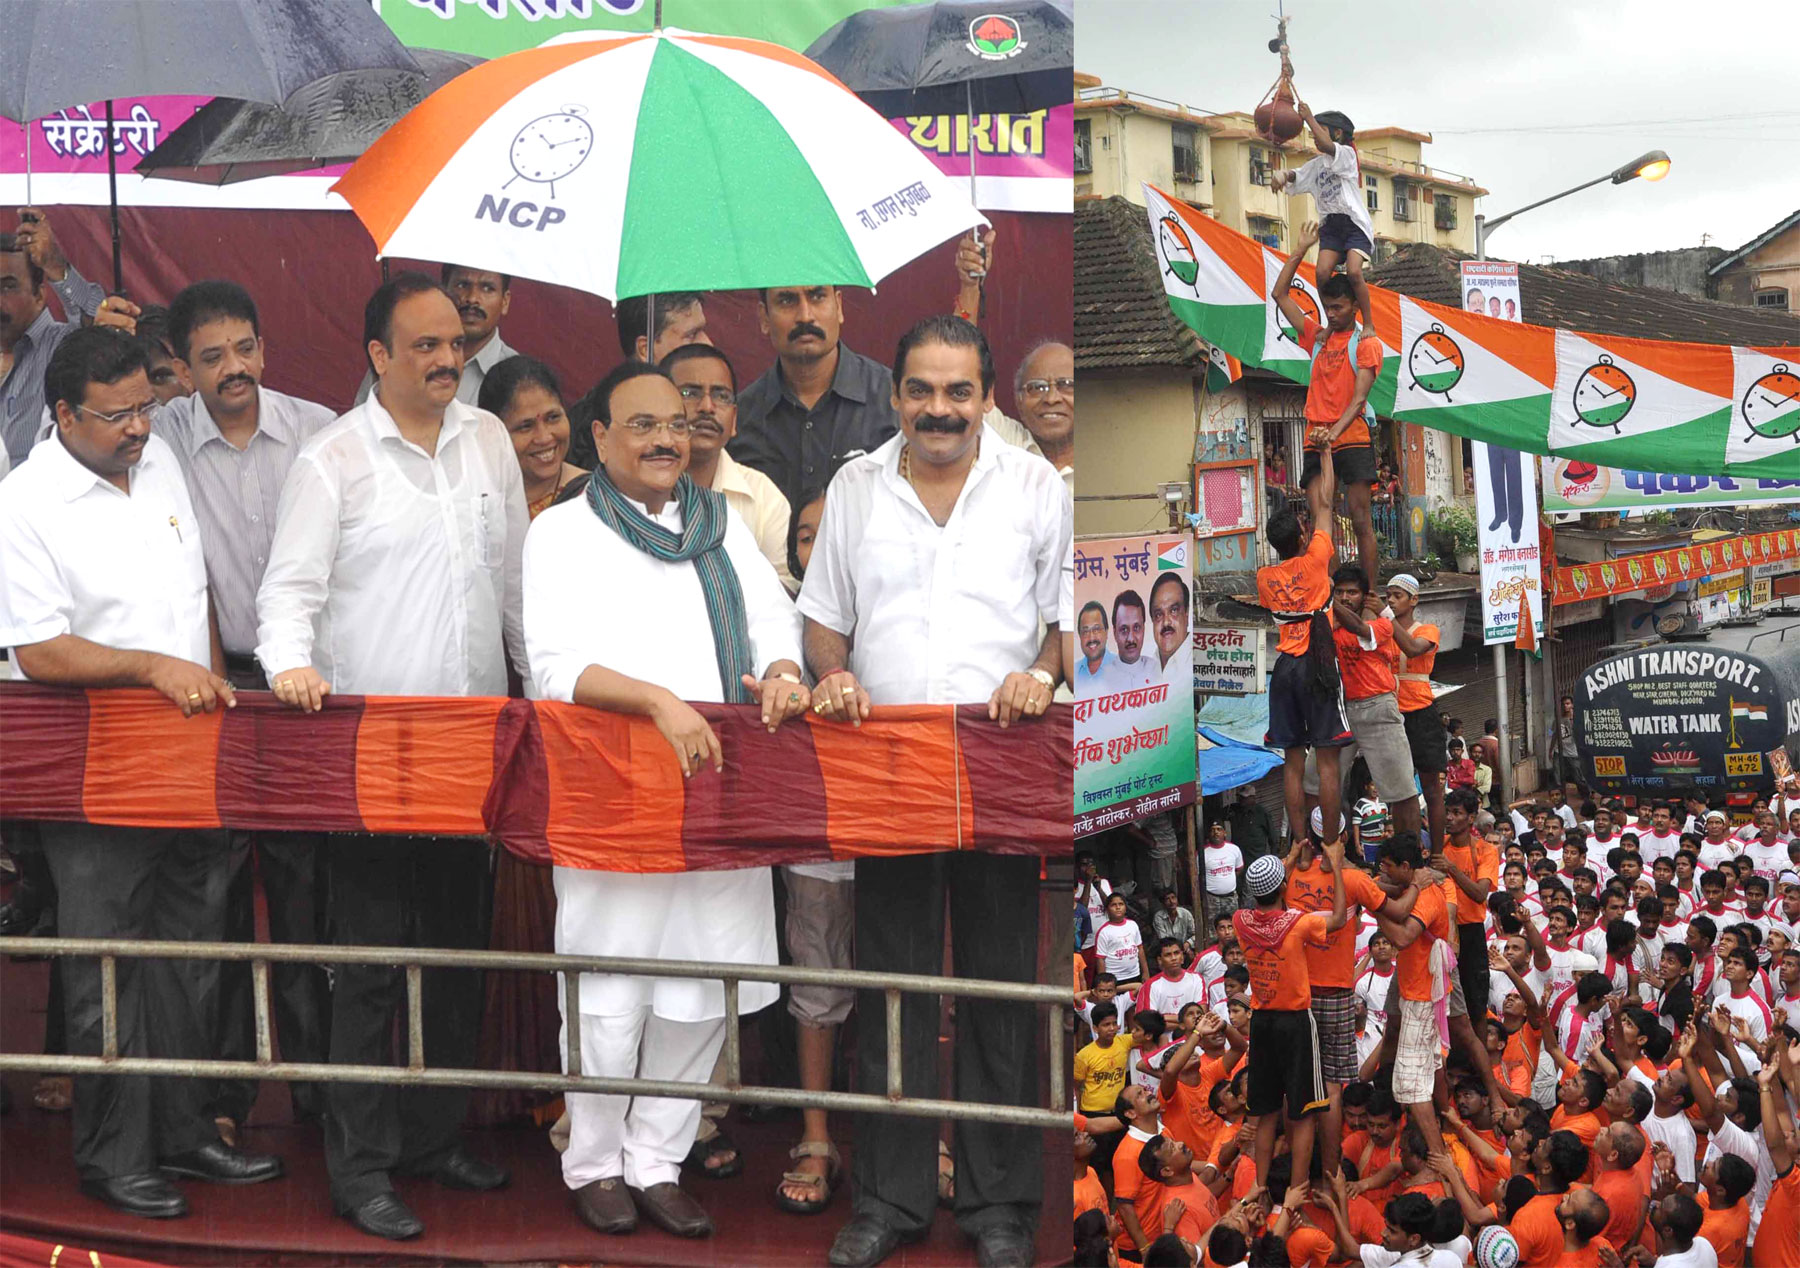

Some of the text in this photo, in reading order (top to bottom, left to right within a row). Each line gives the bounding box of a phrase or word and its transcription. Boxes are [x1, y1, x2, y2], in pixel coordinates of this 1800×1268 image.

[474, 193, 567, 232] NCP
[1113, 541, 1151, 581] मुंबई
[1193, 629, 1246, 651] सुदर्शन
[1230, 648, 1254, 662] होम
[1584, 650, 1761, 701] ASHNI TRANSPORT.
[1098, 678, 1170, 716] पथकांना
[1628, 713, 1722, 736] WATER TANK
[1106, 723, 1170, 765] शुभेच्छा!
[1595, 759, 1623, 773] STOP
[1082, 773, 1164, 806] विश्वस्त मुंबई पोर्ट ट्रस्ट
[1136, 797, 1159, 815] रोहीत
